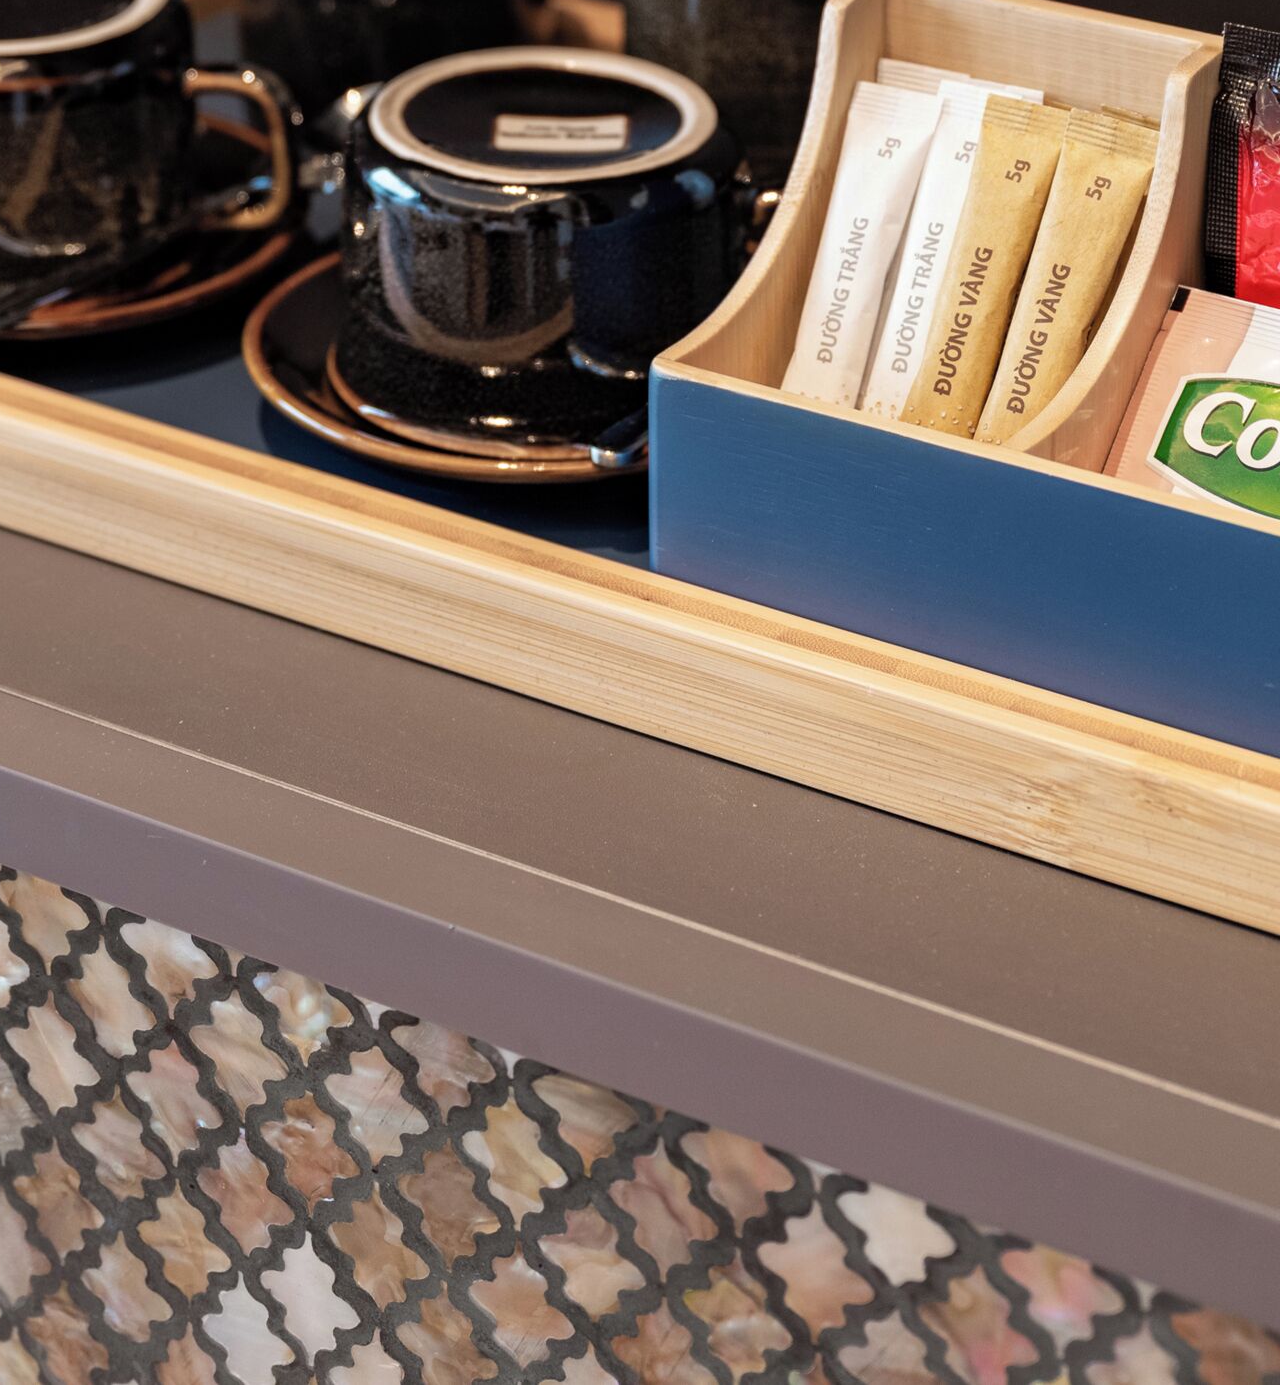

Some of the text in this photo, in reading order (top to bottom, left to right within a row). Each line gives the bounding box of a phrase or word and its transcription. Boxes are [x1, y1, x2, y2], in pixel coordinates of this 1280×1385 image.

[878, 137, 901, 159] 5g
[955, 140, 977, 163] 5g
[1005, 159, 1031, 183] 5g
[1086, 176, 1111, 200] 5g
[817, 217, 869, 364] ĐƯỜNG TRẮNG
[891, 222, 944, 373] ĐƯỜNG TRẮNG
[933, 247, 993, 396] ĐƯỜNG VÀNG
[1006, 264, 1070, 414] ĐƯỜNG VÀNG
